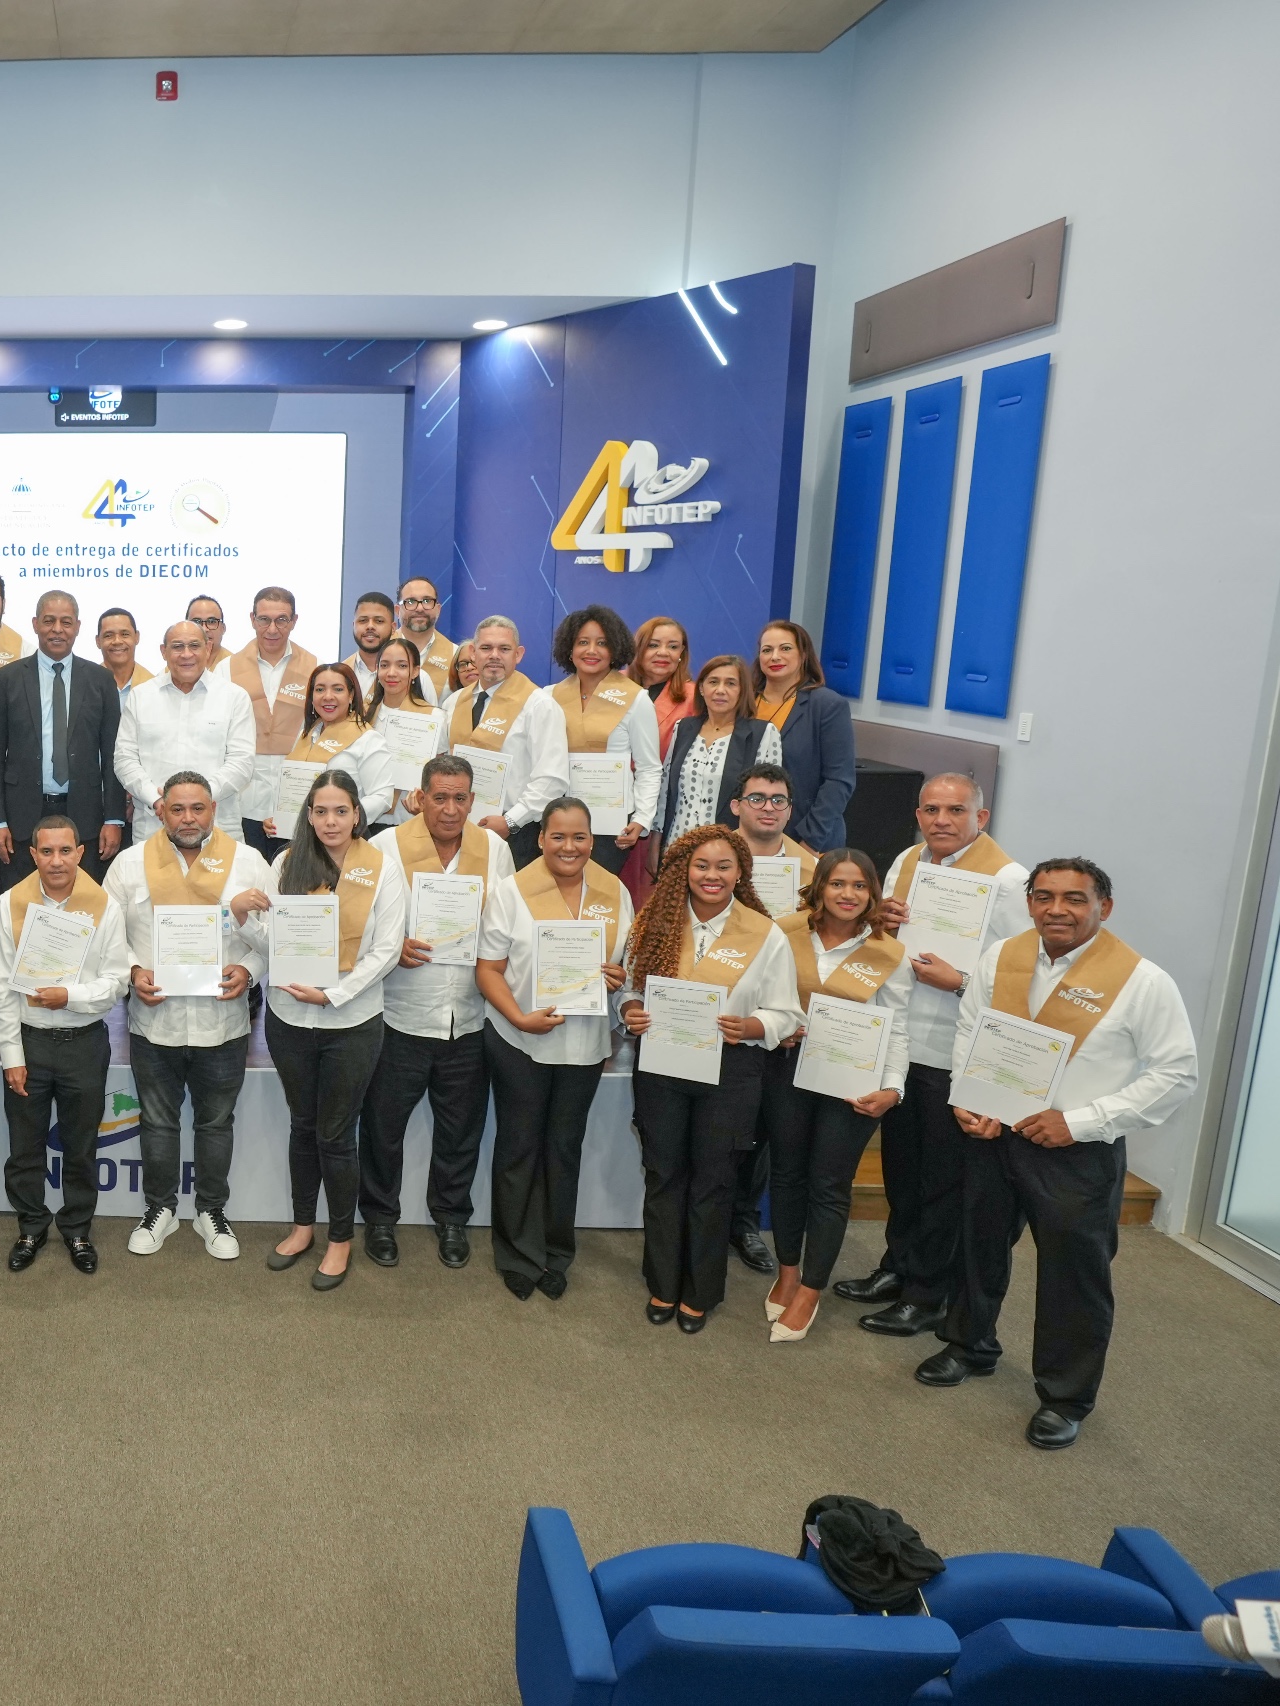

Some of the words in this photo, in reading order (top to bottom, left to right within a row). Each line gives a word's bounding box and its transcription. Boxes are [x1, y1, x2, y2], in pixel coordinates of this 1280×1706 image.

[116, 503, 155, 512] INFOTEP
[622, 500, 722, 527] INFOTEP
[32, 542, 50, 557] de
[56, 543, 116, 560] entrega
[122, 543, 139, 557] de
[146, 543, 239, 558] certificados
[19, 566, 27, 578] a
[32, 563, 110, 578] miembros
[115, 564, 133, 578] de
[139, 564, 209, 578] DIECOM
[428, 657, 449, 671] INFOTEP
[280, 687, 307, 701] INFOTEP
[598, 692, 627, 706] INFOTEP
[478, 722, 506, 736] INFOTEP
[344, 873, 375, 887] INFOTEP
[928, 884, 949, 892] Certificado
[582, 908, 615, 924] INFOTEP
[707, 951, 745, 970] INFOTEP
[842, 963, 878, 988] INFOTEP
[1057, 989, 1102, 1014] INFOTEP
[992, 1031, 1016, 1043] Certificado
[1023, 1041, 1049, 1054] Aprobación
